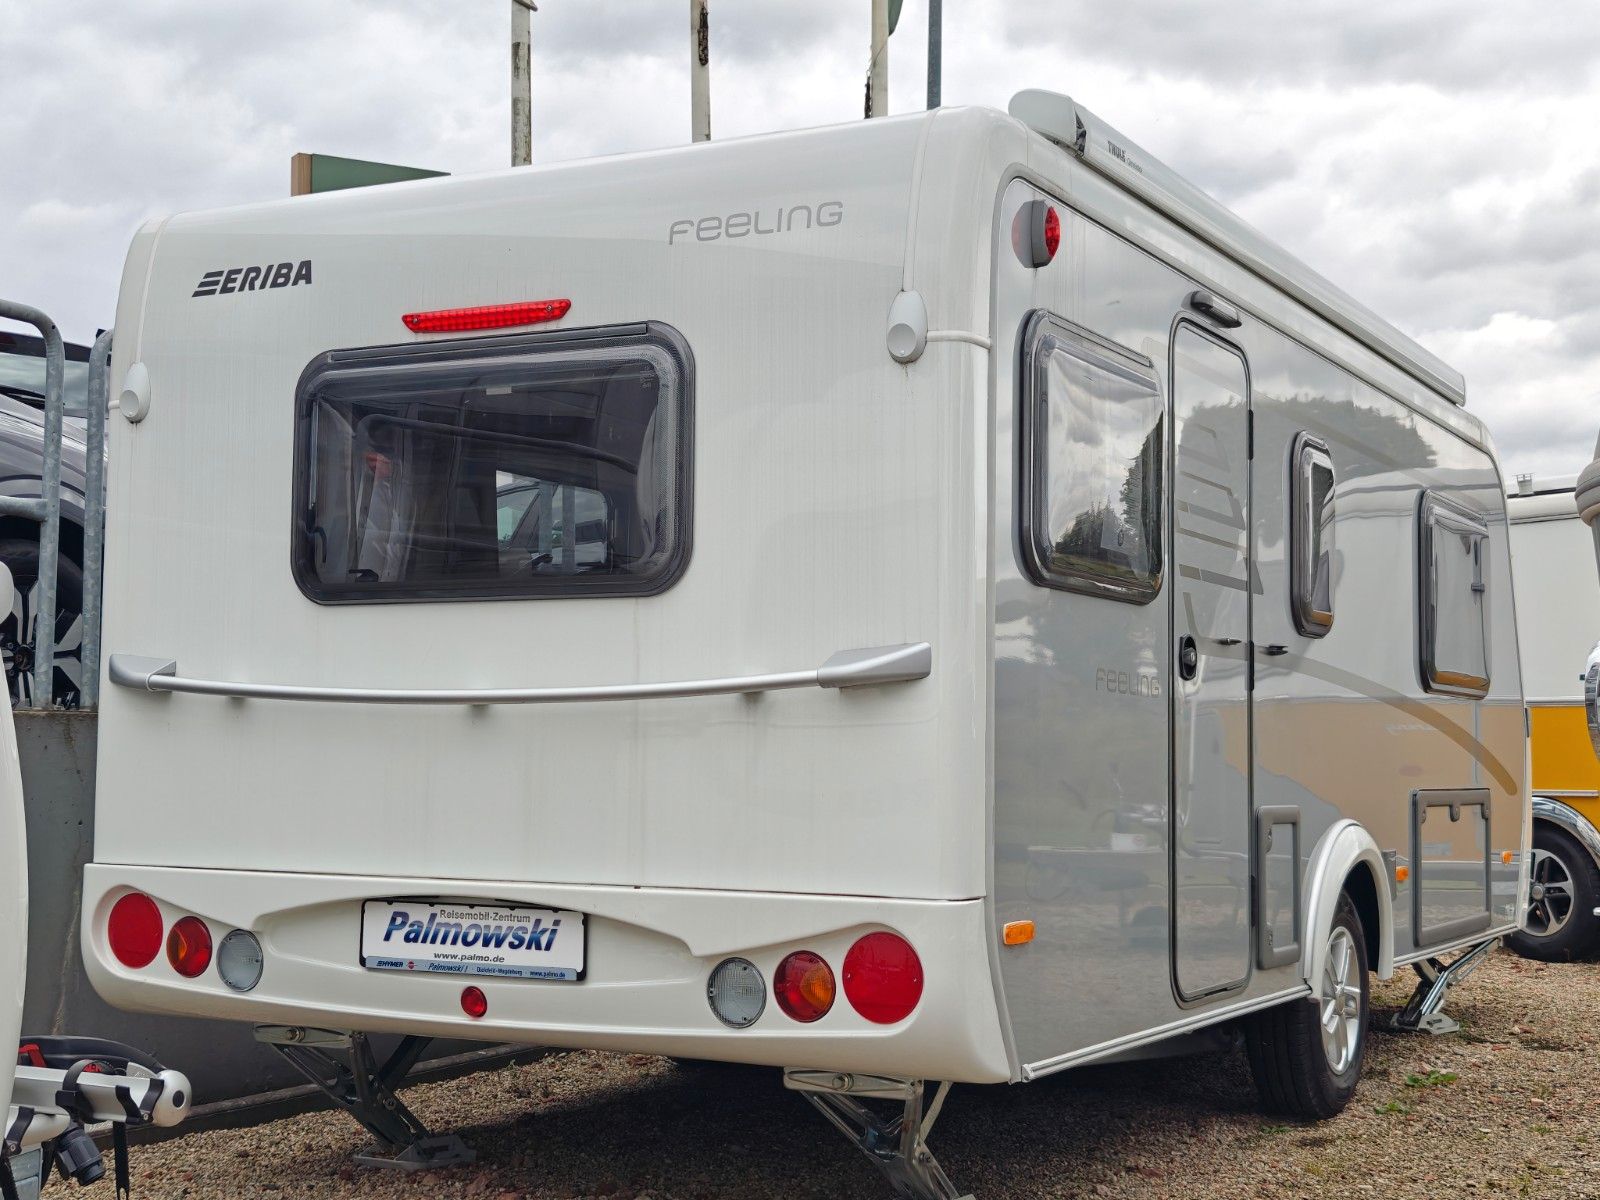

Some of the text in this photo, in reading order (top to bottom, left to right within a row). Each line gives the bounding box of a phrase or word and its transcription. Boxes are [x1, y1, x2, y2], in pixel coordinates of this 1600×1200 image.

[217, 259, 312, 295] ERIBA
[439, 909, 531, 923] Reisemobil-Zentrum
[382, 911, 562, 952] Palmowski
[433, 952, 505, 963] www.palmo.de
